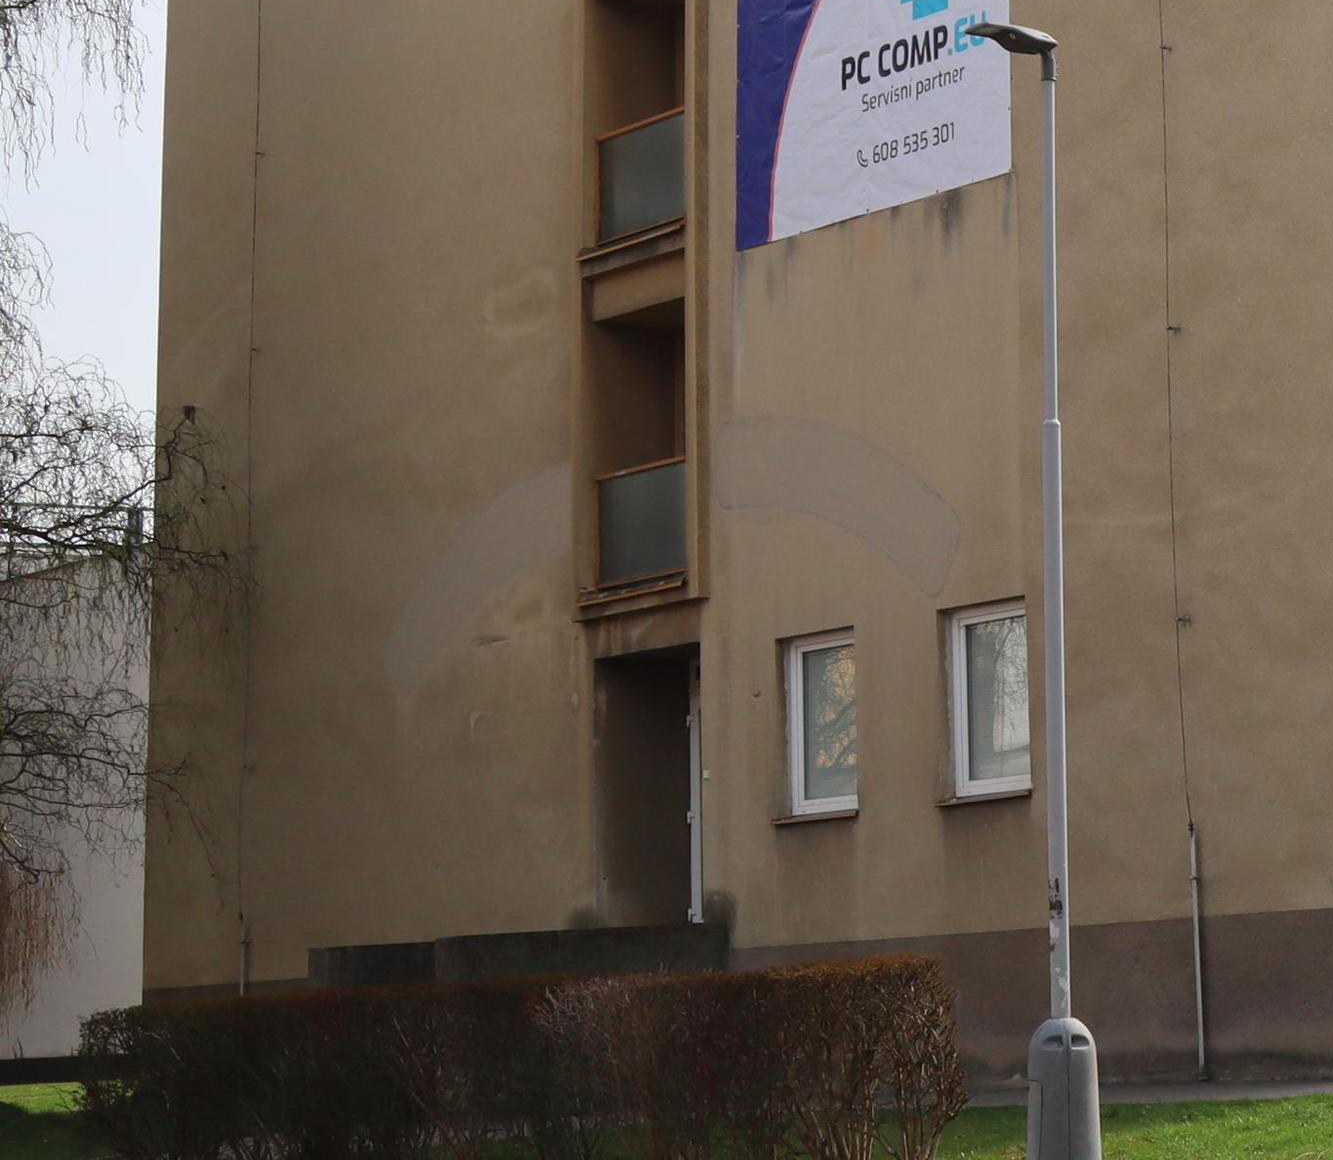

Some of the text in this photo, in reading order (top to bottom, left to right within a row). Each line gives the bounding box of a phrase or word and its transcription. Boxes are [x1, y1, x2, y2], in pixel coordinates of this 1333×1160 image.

[841, 51, 871, 91] PC
[915, 66, 965, 101] partner
[872, 121, 955, 164] 608 535 301
